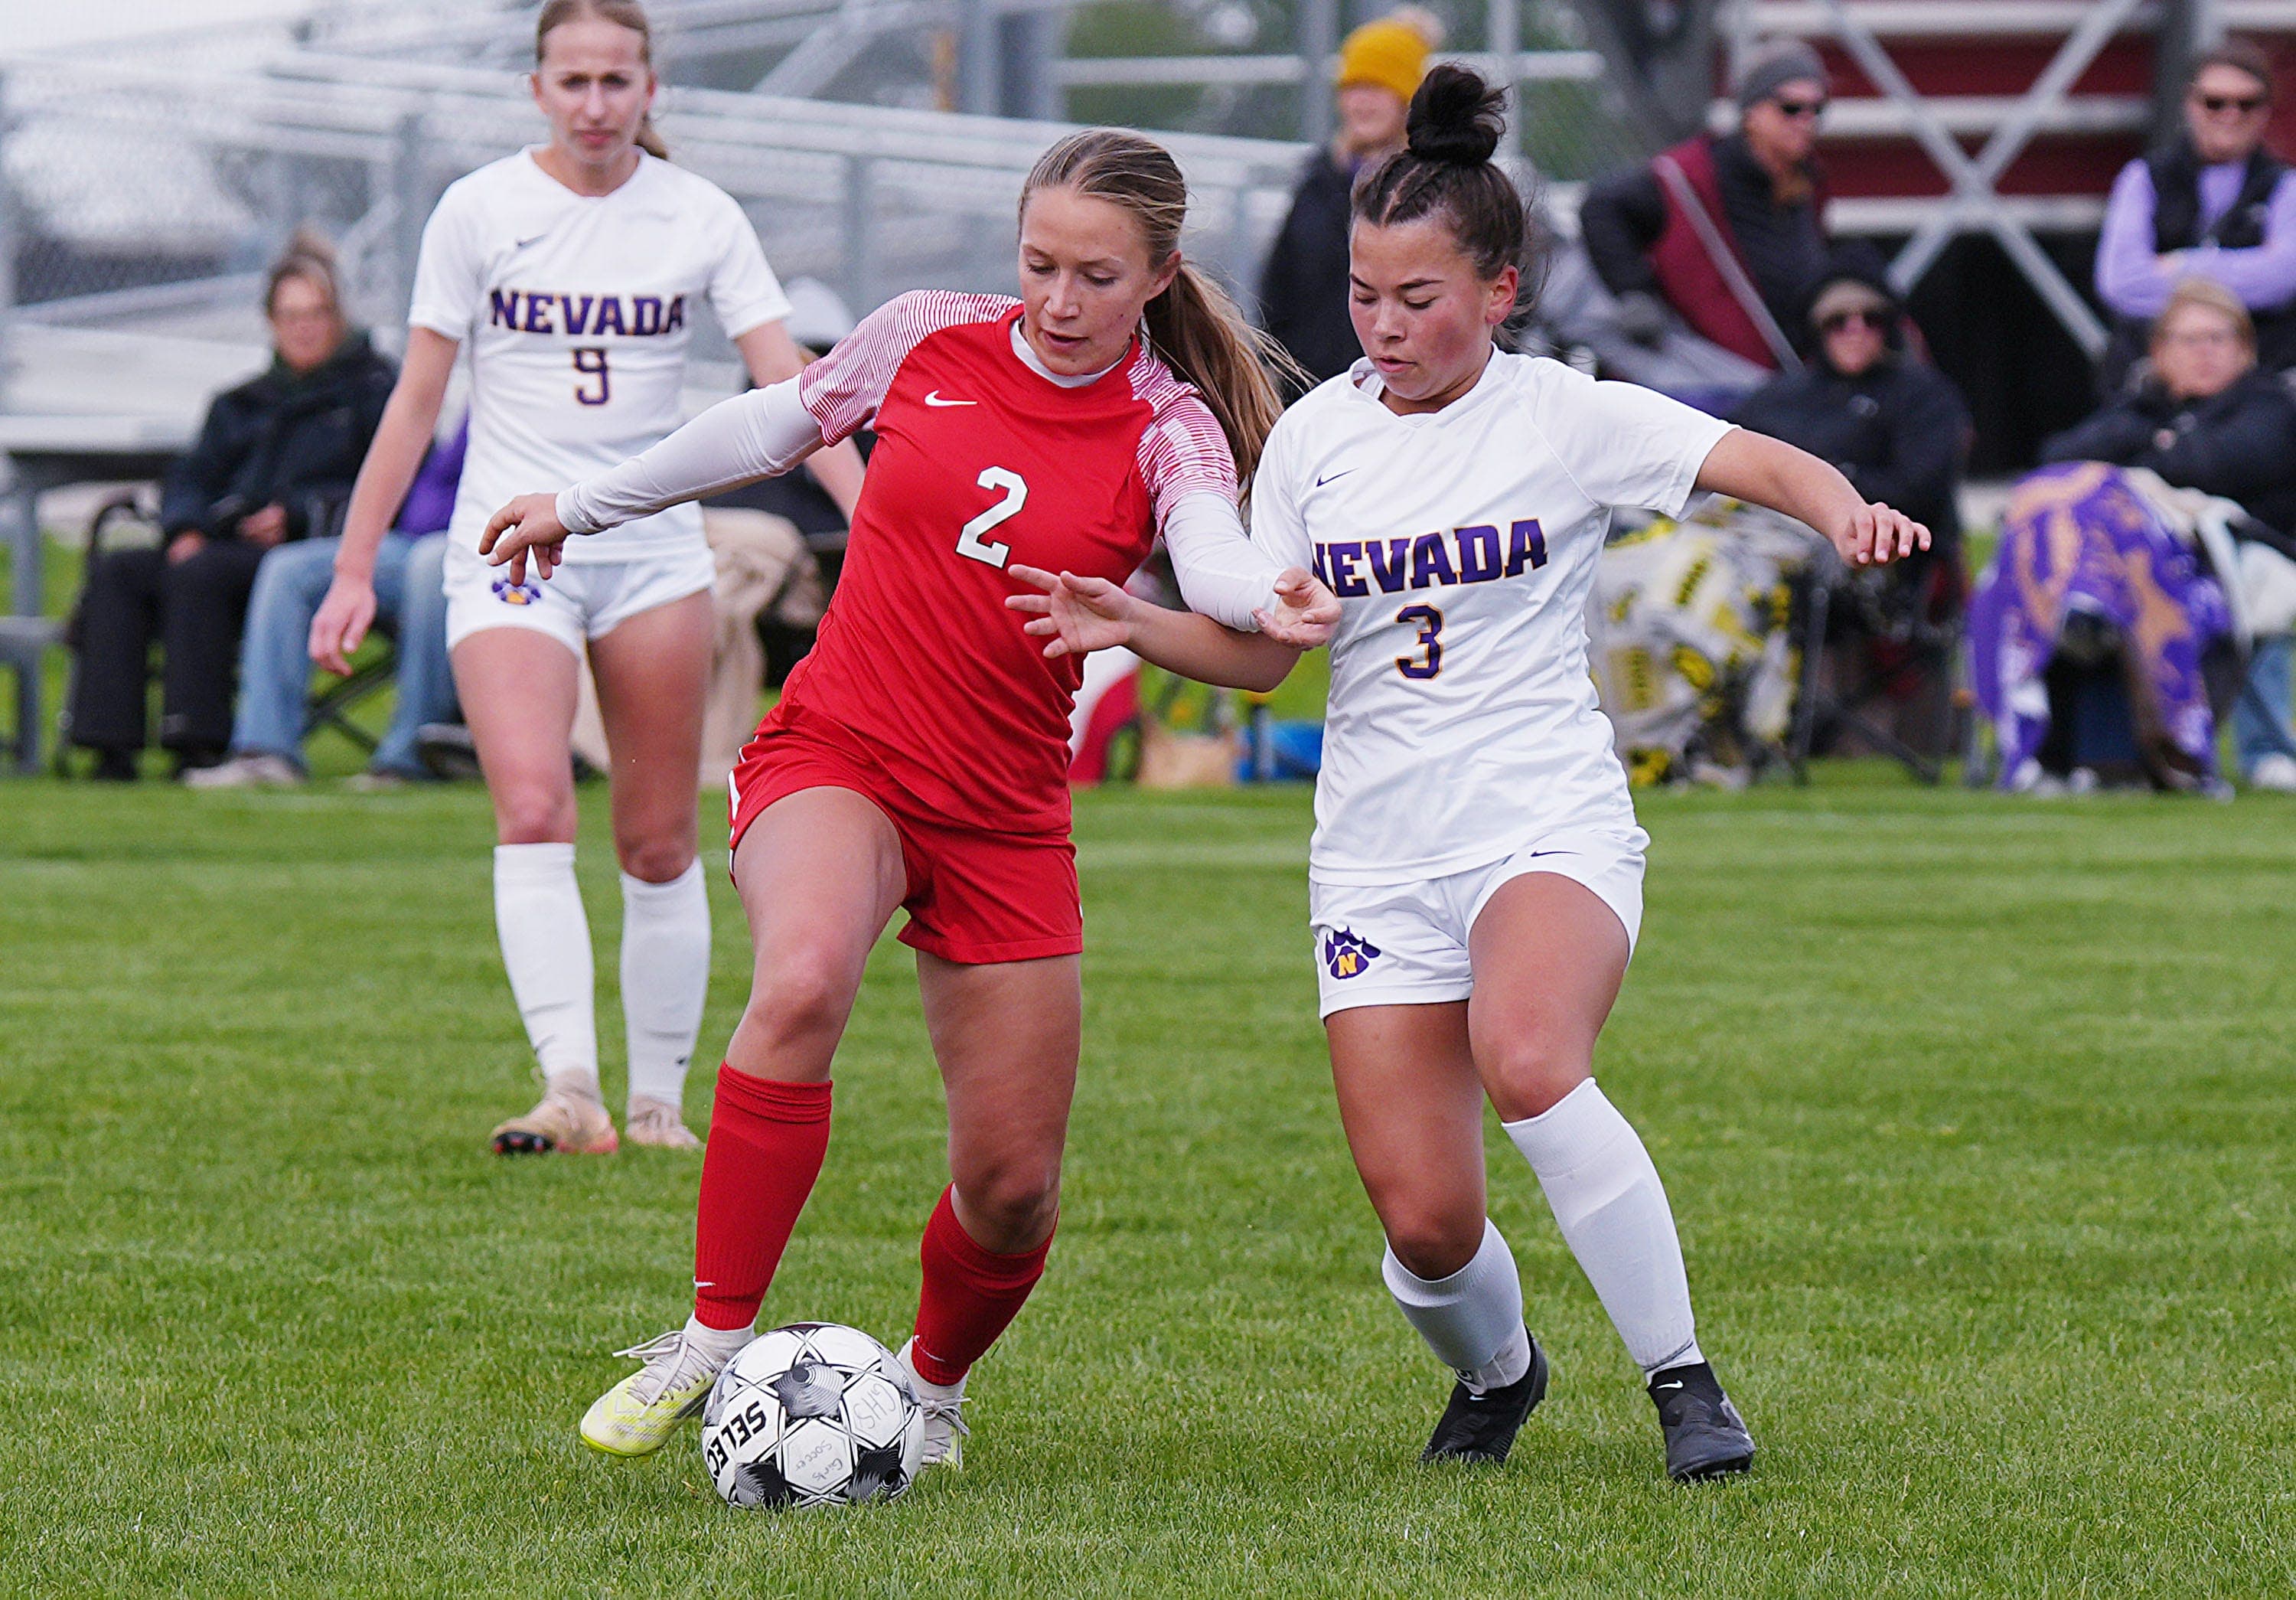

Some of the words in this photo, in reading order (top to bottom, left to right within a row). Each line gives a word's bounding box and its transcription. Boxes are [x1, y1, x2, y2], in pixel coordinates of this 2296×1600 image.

[490, 287, 687, 336] NEVADA
[573, 348, 610, 407] 9
[956, 465, 1029, 569] 2
[1394, 602, 1444, 680] 3
[1338, 952, 1358, 977] N
[853, 1383, 896, 1429] GHS
[811, 1458, 843, 1481] Girls
